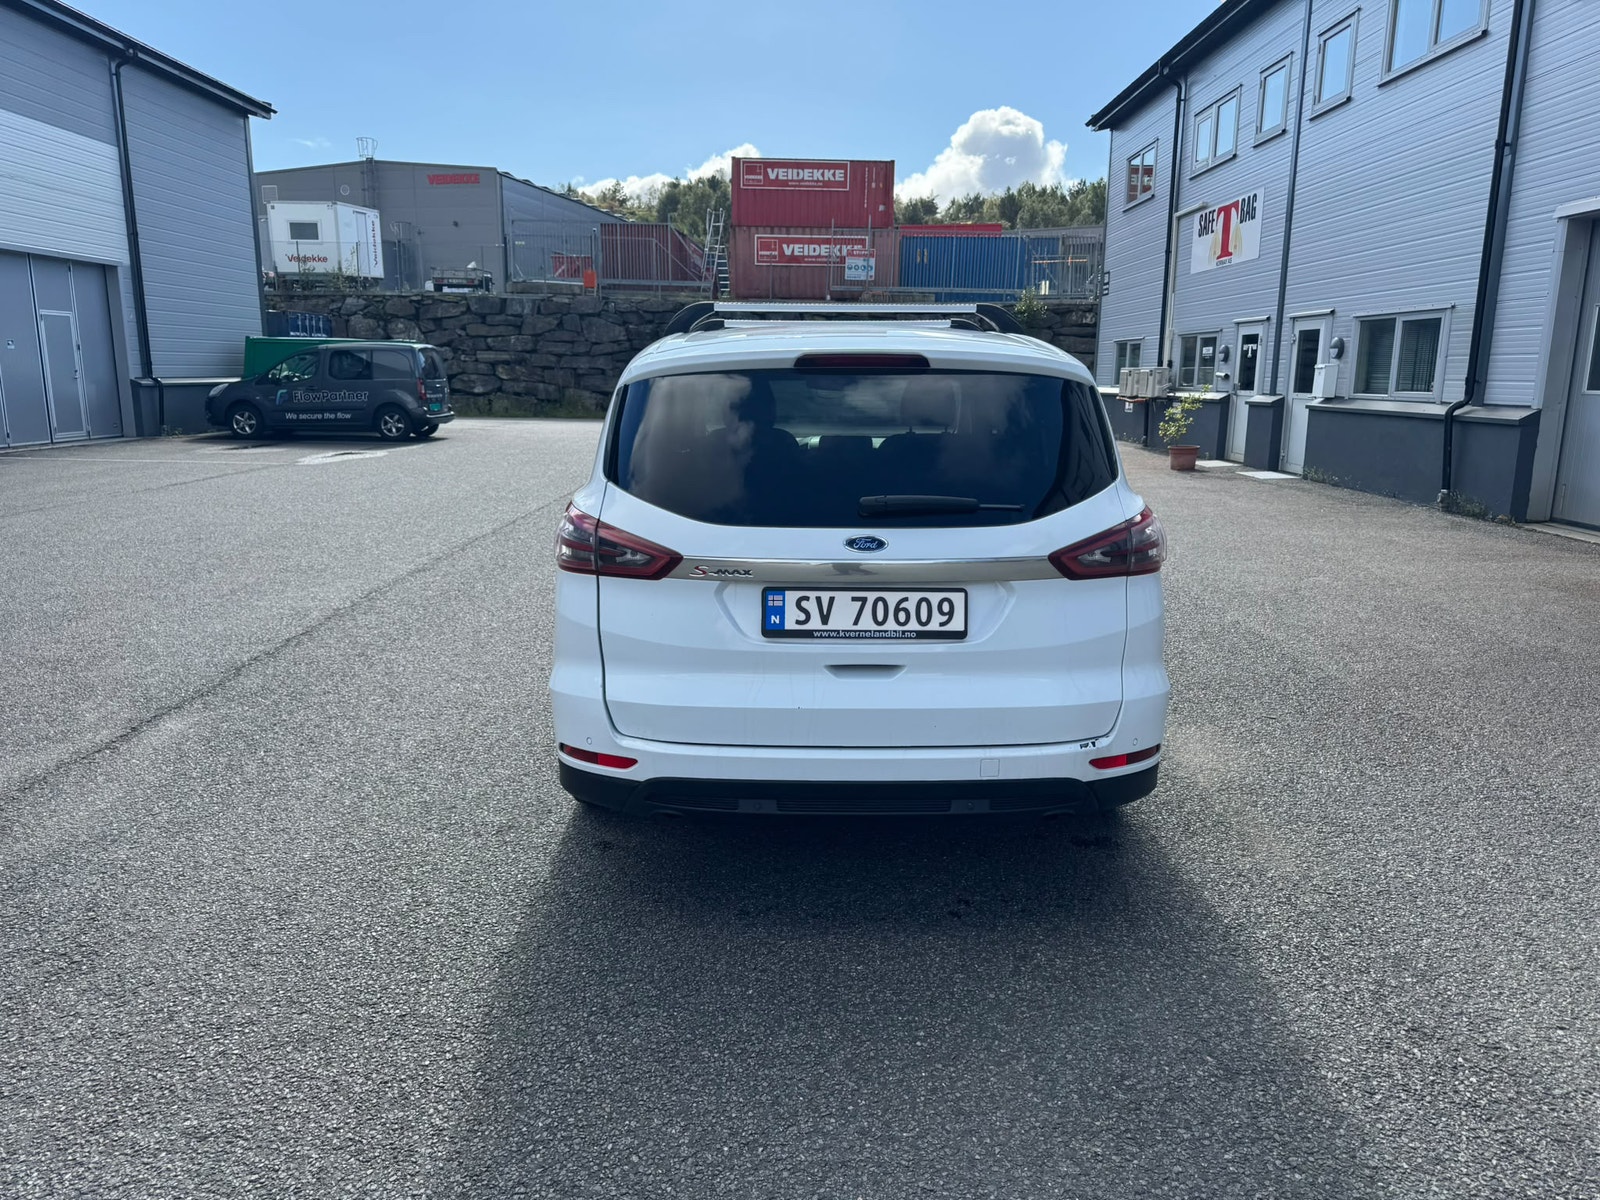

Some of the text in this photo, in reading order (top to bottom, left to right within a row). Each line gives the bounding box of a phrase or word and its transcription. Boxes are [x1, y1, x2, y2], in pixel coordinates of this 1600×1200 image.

[767, 168, 845, 181] VEIDEKKE
[1198, 193, 1257, 260] SAFE T BAG
[293, 390, 368, 402] FlowPartner
[853, 538, 878, 549] Ford
[690, 565, 753, 577] S-MAX
[771, 595, 955, 627] N SV 70609
[813, 629, 917, 638] www.kvernelandbil.no
